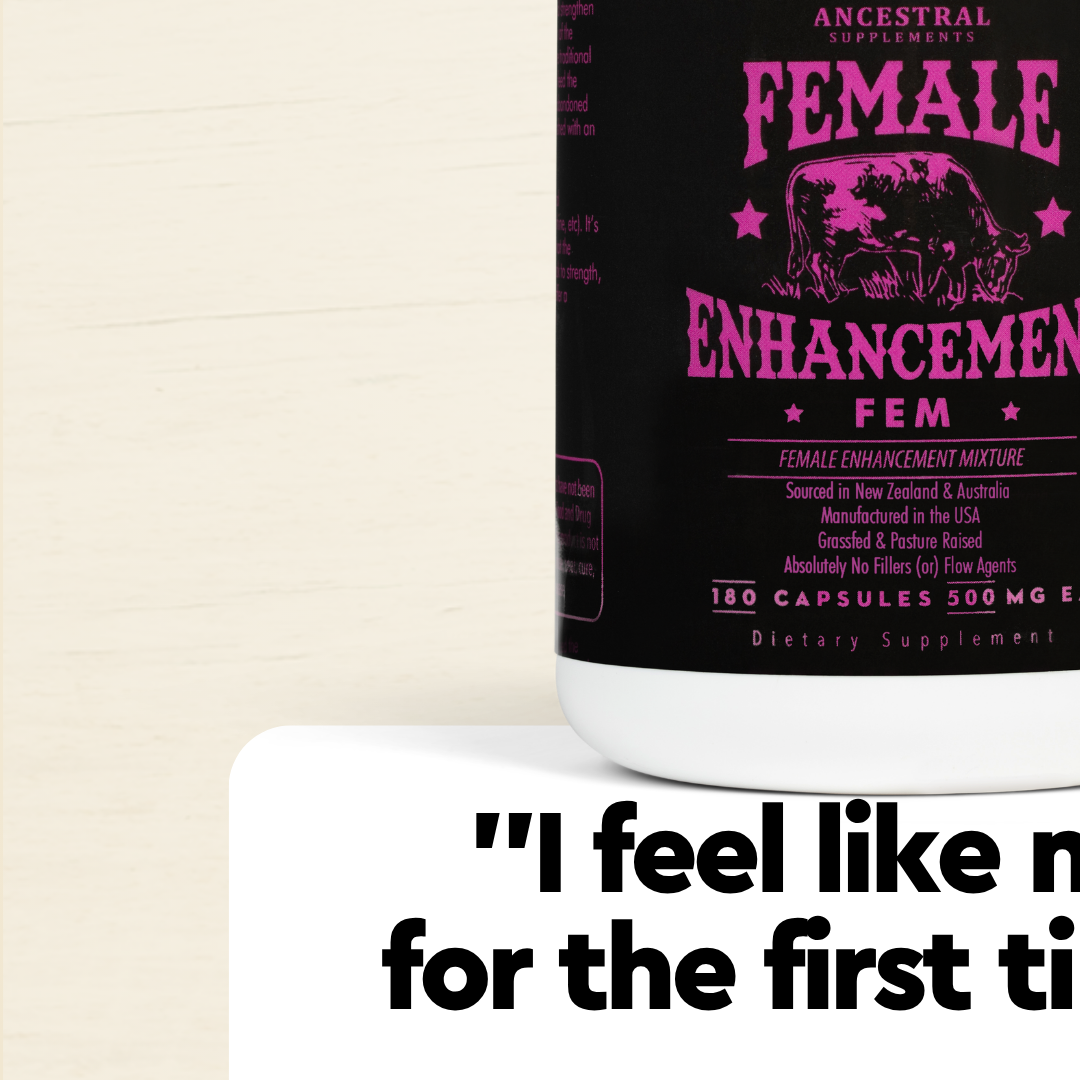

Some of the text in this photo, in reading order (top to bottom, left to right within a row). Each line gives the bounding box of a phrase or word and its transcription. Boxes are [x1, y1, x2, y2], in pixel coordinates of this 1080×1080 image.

[814, 7, 990, 26] ANCESTRAL
[830, 32, 974, 43] SUPPLEMENTS
[743, 60, 1060, 169] FEMALE
[567, 118, 581, 136] with
[584, 124, 596, 136] an
[567, 262, 601, 285] strength,
[856, 398, 950, 427] FEM
[779, 448, 1025, 468] FEMALE ENHANCEMENT MIXTURE
[577, 478, 595, 498] been
[786, 480, 1010, 500] Sourced in New Zealand & Australia
[575, 505, 592, 528] Drug
[821, 505, 981, 524] Manufactured in the USA
[587, 535, 599, 550] not
[818, 530, 983, 549] Grassfed & Pasture Raised
[784, 555, 1017, 579] Absolutely No Fillers (or) Flow Agents
[712, 588, 756, 606] 180
[774, 589, 932, 607] CAPSULES
[948, 588, 995, 606] 500
[1007, 587, 1046, 605] MG
[752, 628, 1054, 651] Dietary Supplement
